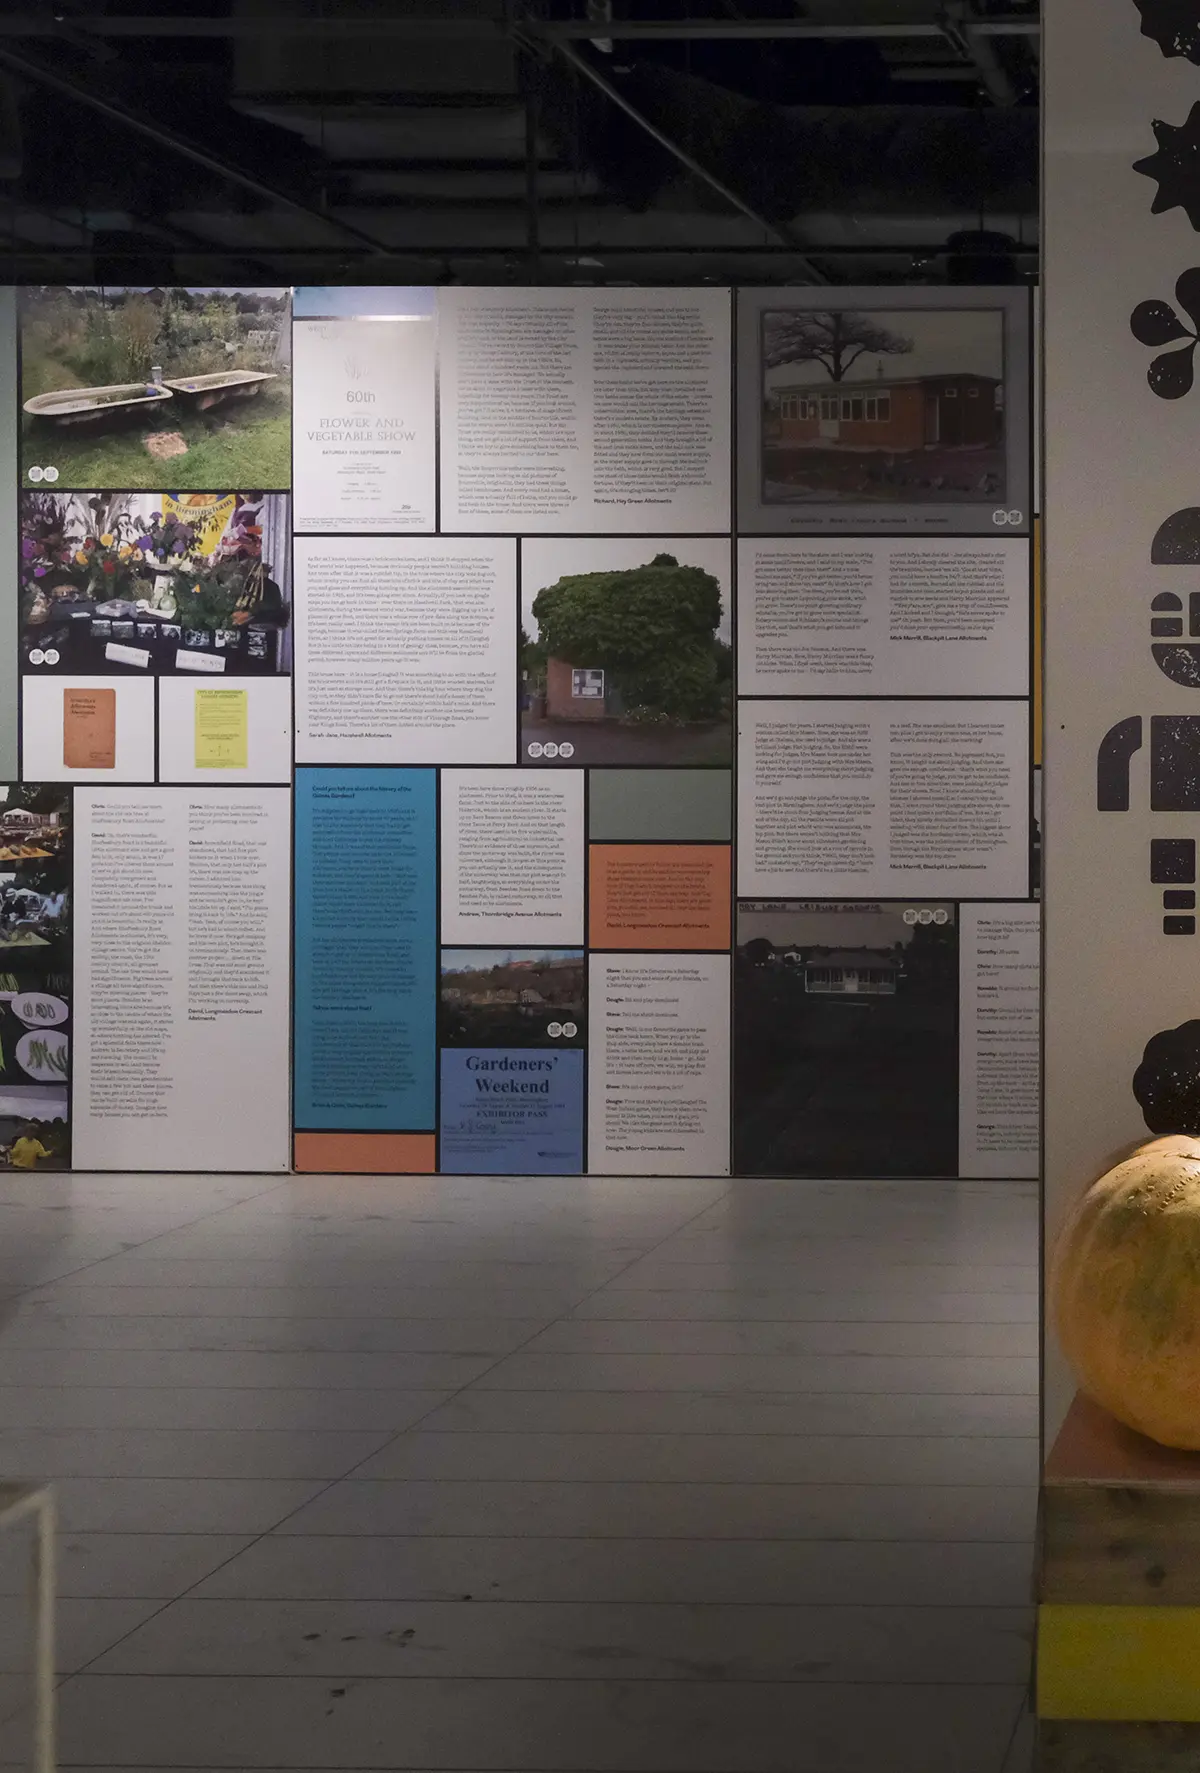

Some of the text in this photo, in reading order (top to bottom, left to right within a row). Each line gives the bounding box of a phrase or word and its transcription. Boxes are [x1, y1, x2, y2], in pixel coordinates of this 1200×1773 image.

[347, 390, 376, 403] 60th
[320, 418, 404, 428] FLOWER AND
[307, 431, 417, 441] VEGETABLE SHOW
[466, 1056, 558, 1071] Gardeners'
[476, 1078, 549, 1093] Weekend
